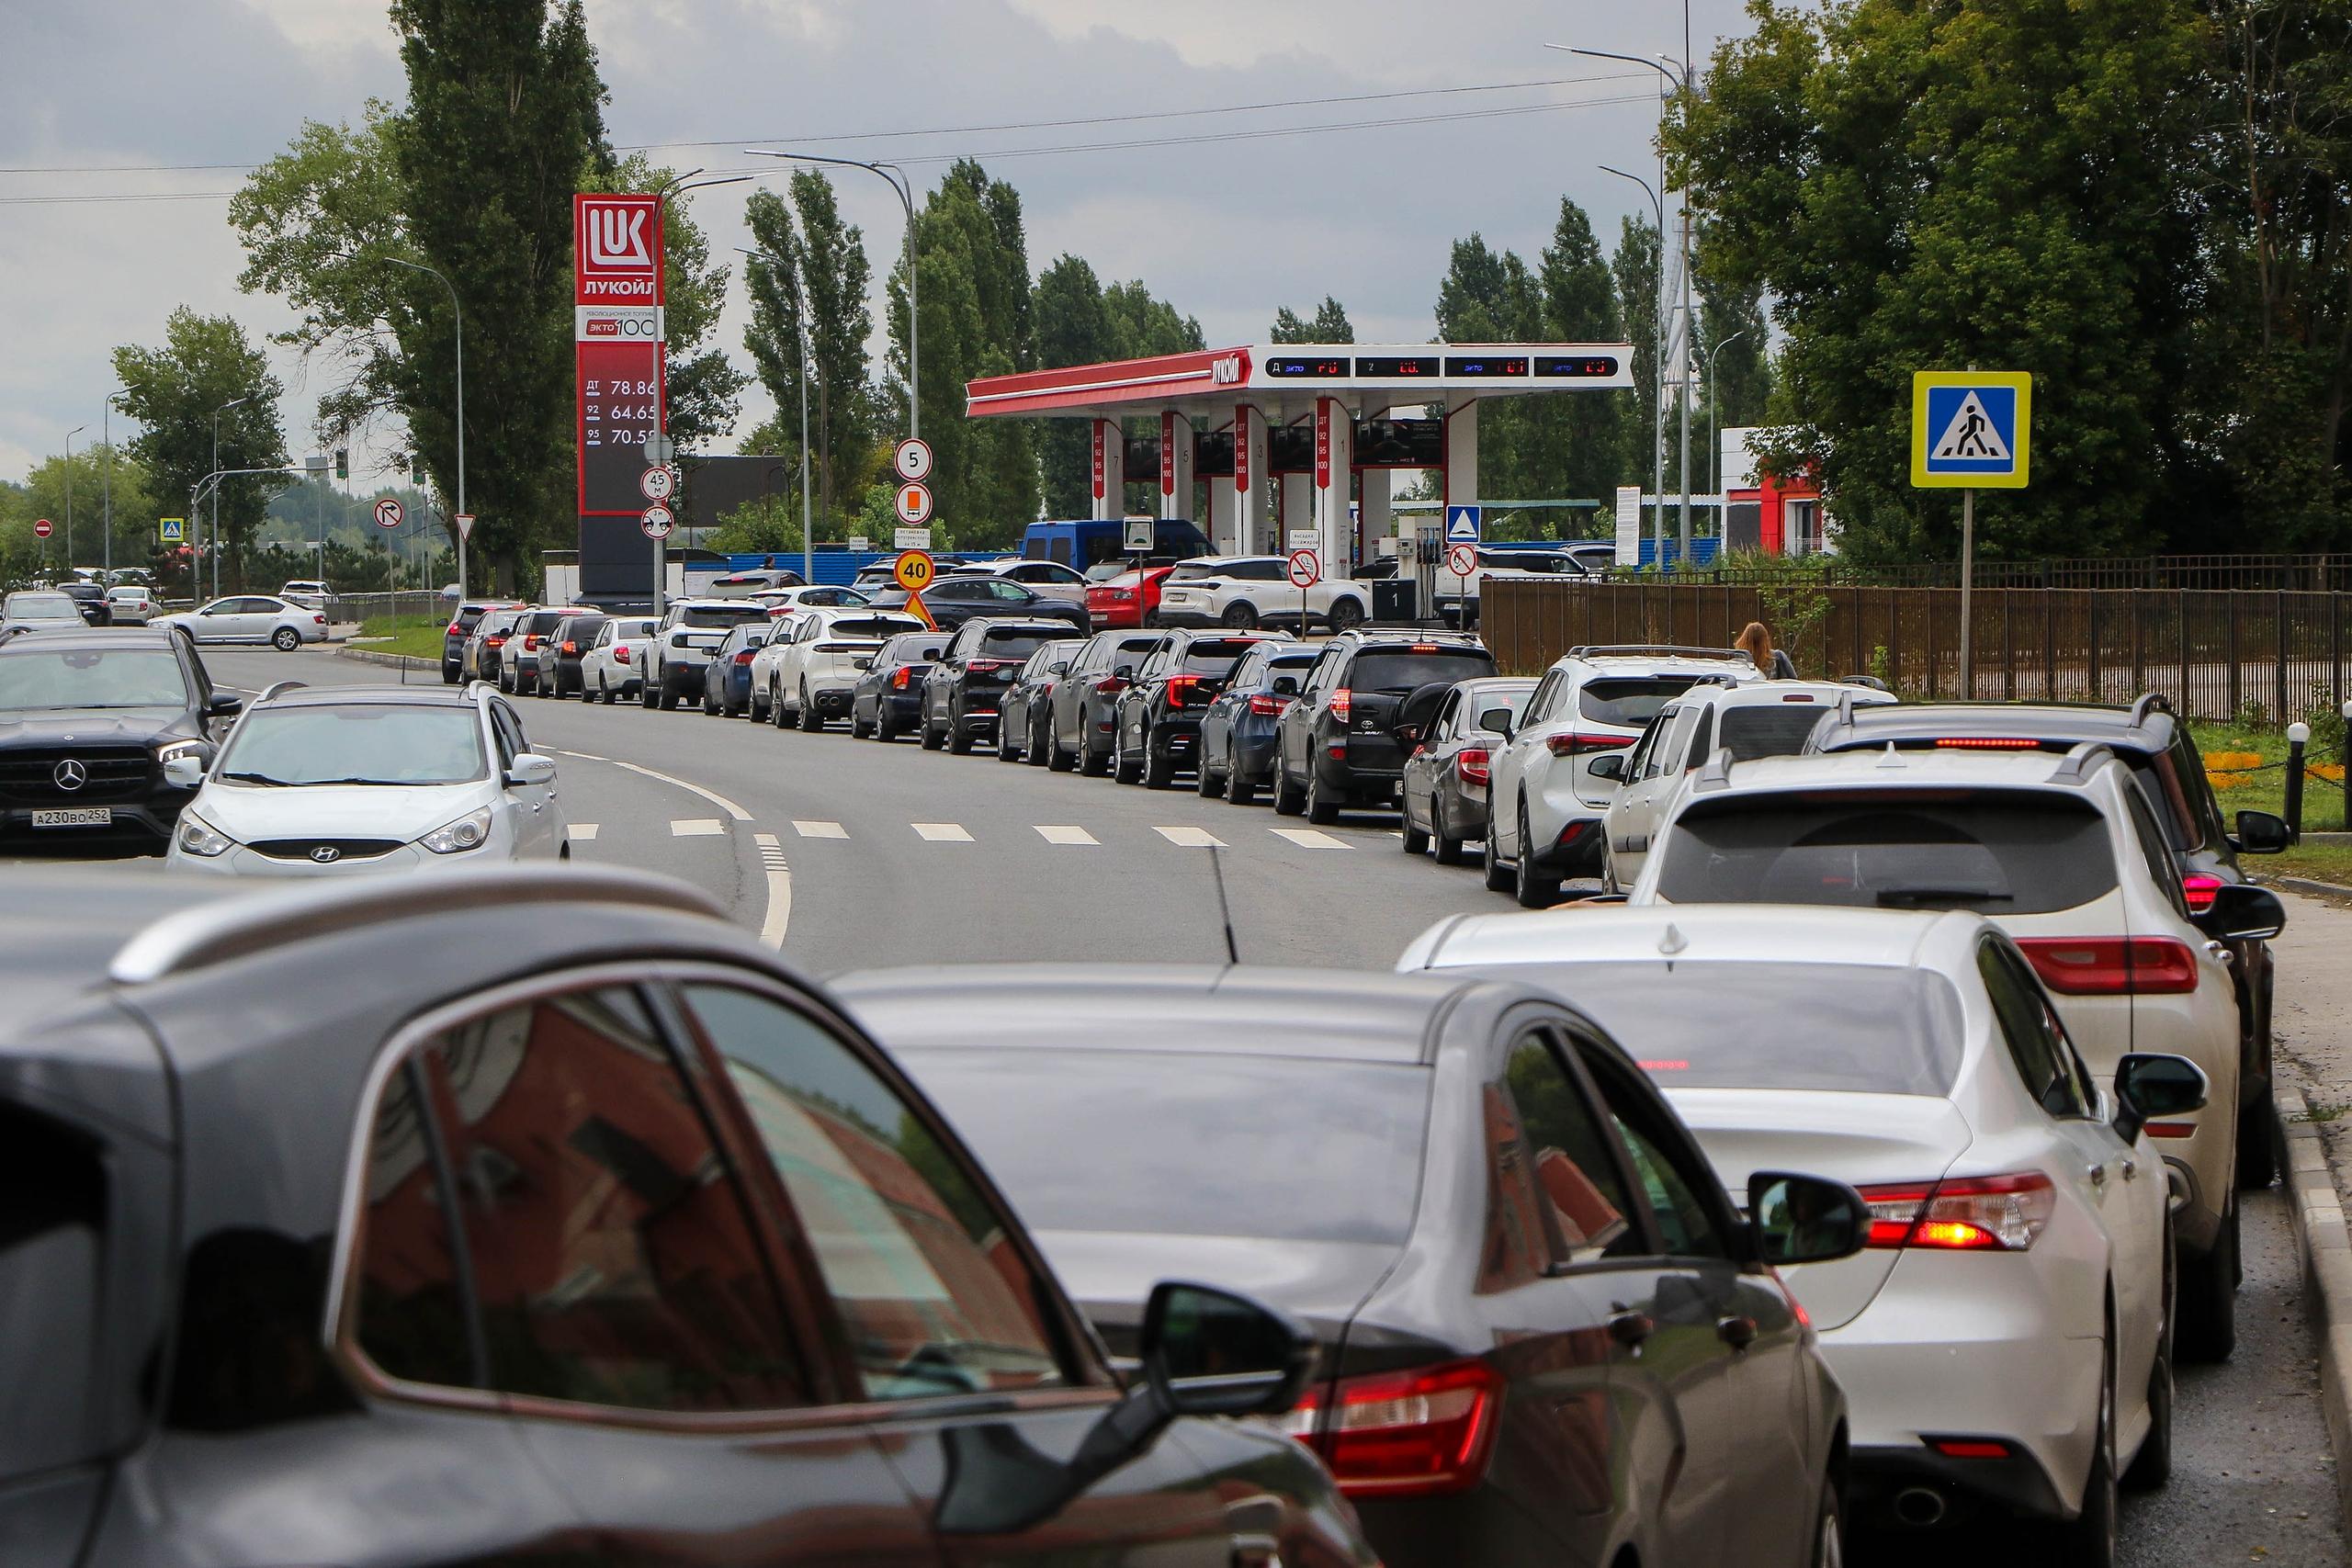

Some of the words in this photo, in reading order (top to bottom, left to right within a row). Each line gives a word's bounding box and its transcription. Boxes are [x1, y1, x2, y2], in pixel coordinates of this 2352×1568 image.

[584, 278, 654, 295] ЛУКОЙЛ
[589, 323, 615, 332] ЭКТО
[1212, 353, 1239, 384] ЛУКОЙЛ
[586, 380, 600, 390] ДТ
[587, 405, 599, 414] 92
[1317, 416, 1328, 425] ДТ
[1237, 423, 1246, 432] ДТ
[587, 429, 600, 438] 95
[1163, 429, 1171, 437] ДТ
[1318, 432, 1327, 440] 92
[1094, 435, 1102, 444] ДТ
[1163, 443, 1171, 451] 92
[1258, 445, 1263, 457] 3
[1318, 446, 1327, 455] 95
[909, 452, 919, 468] 5
[1183, 450, 1189, 463] 5
[1094, 461, 1102, 469] 95
[1114, 456, 1119, 468] 7
[1317, 461, 1328, 469] 100
[1162, 469, 1171, 478] 100
[1237, 466, 1246, 474] 100
[1094, 474, 1102, 482] 100
[903, 562, 926, 579] 40
[1392, 592, 1397, 607] 1
[88, 809, 107, 819] 252
